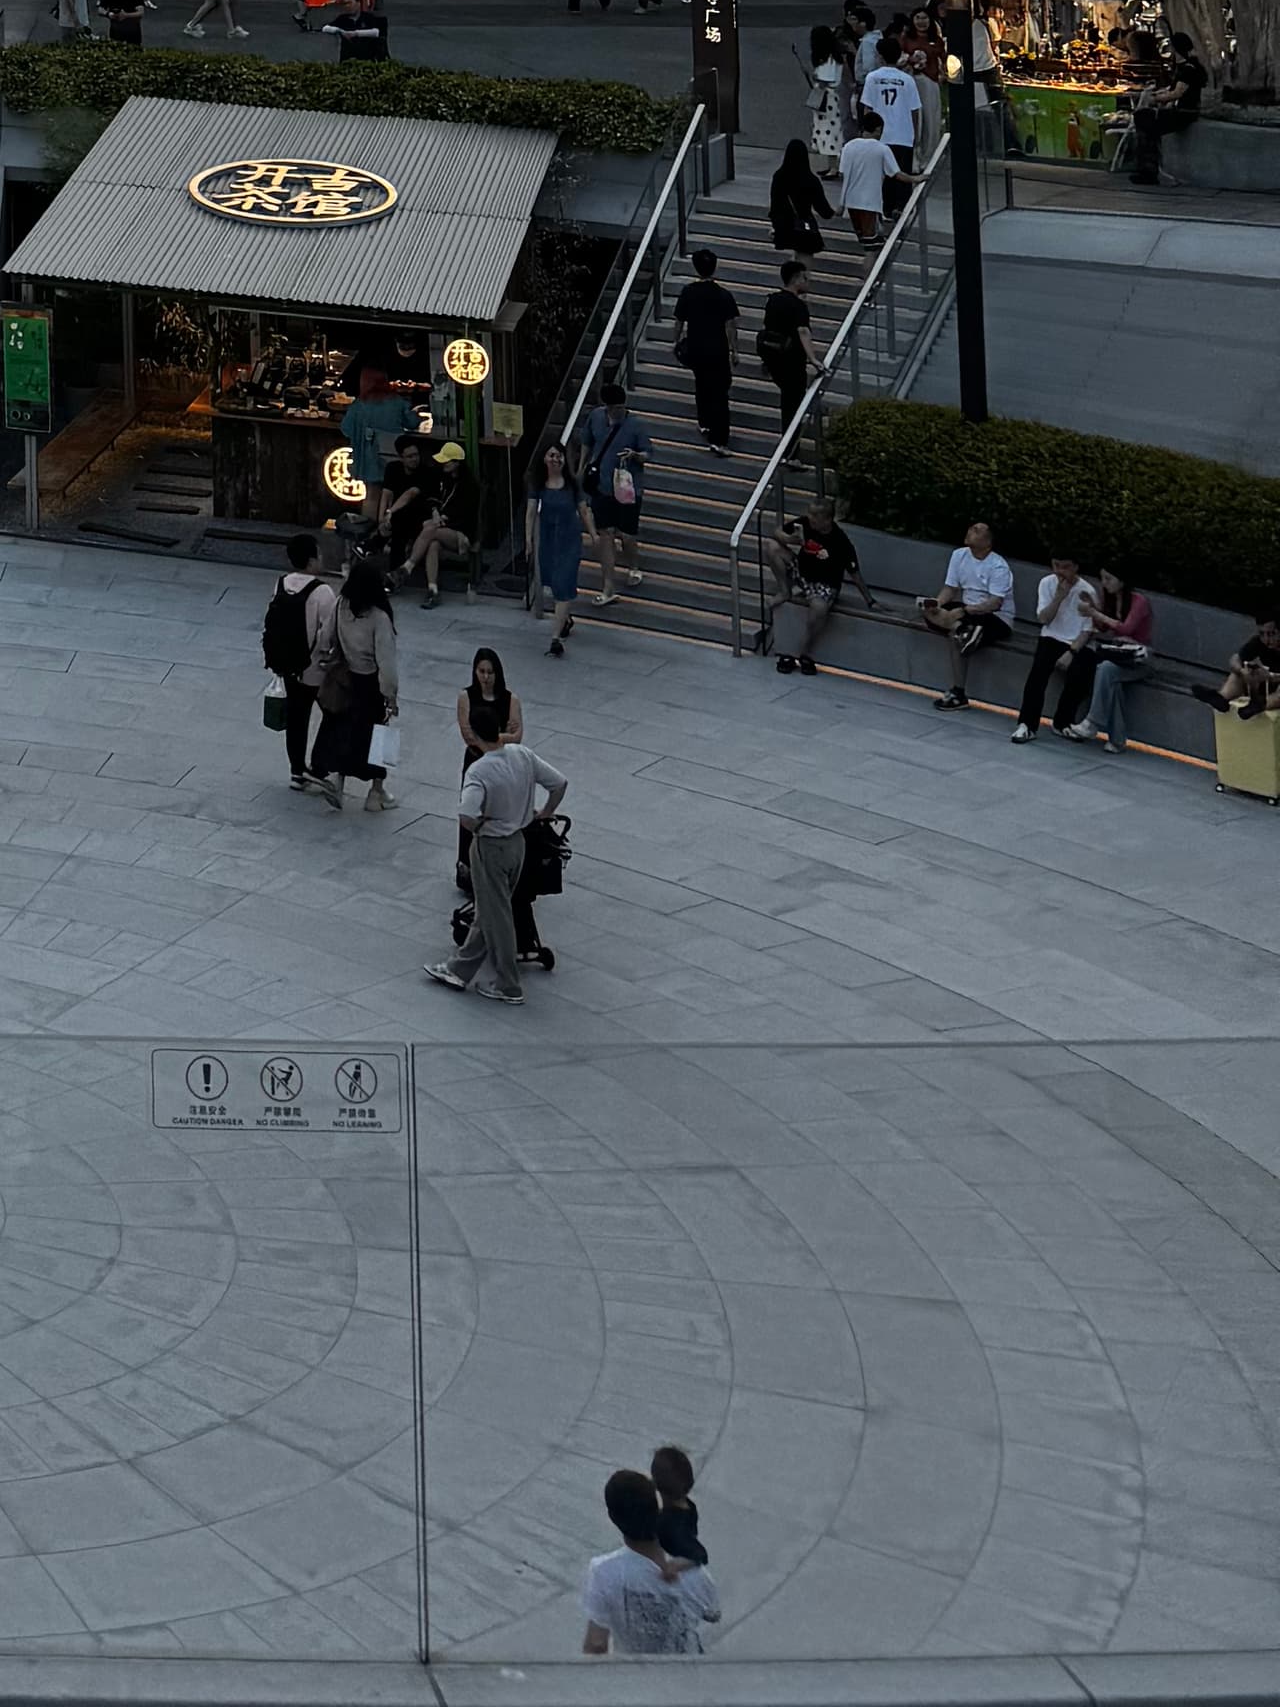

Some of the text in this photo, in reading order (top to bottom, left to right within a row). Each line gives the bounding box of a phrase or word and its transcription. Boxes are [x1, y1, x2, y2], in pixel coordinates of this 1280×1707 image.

[881, 89, 897, 105] 17
[172, 1117, 244, 1126] CAUTION DANGER
[332, 1120, 383, 1129] NO LEANING
